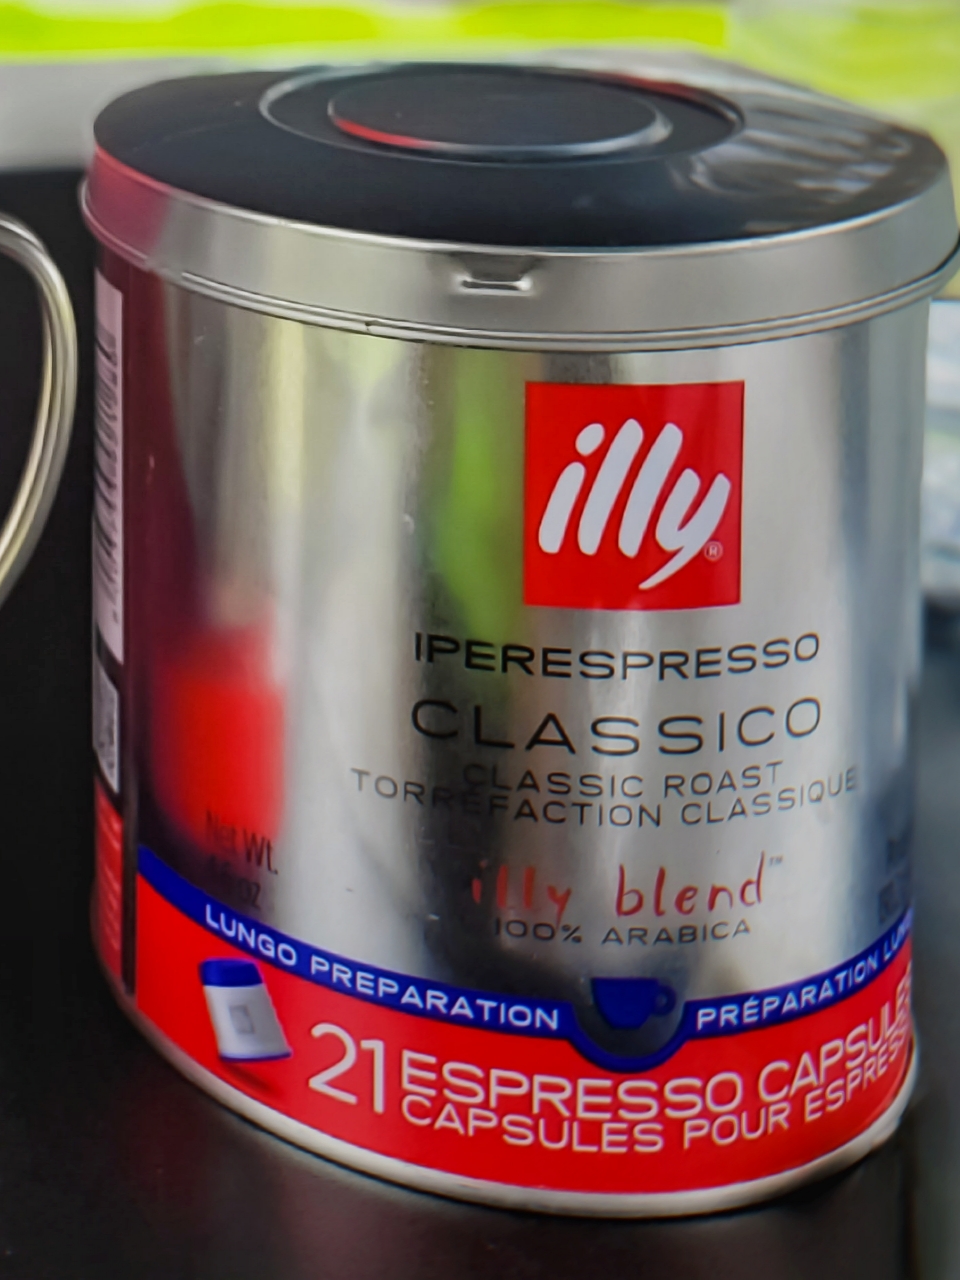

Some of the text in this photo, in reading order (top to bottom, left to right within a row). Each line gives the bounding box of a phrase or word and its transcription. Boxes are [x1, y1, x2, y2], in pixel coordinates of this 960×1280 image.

[414, 632, 820, 681] IPERESPRESSO
[411, 697, 821, 757] CLASSICO
[462, 760, 783, 798] CLASSIC ROAST
[681, 765, 858, 826] CLASSIQUE
[472, 860, 572, 928] illy
[495, 919, 751, 946] 100% ARABICA
[205, 903, 559, 1031] LUNGO PREPARATION
[696, 949, 879, 1032] PRÉPARATION
[309, 1022, 385, 1114] 21
[402, 1049, 743, 1119] ESPRESSO
[402, 1094, 664, 1154] CAPSULES
[683, 1101, 790, 1151] POUR
